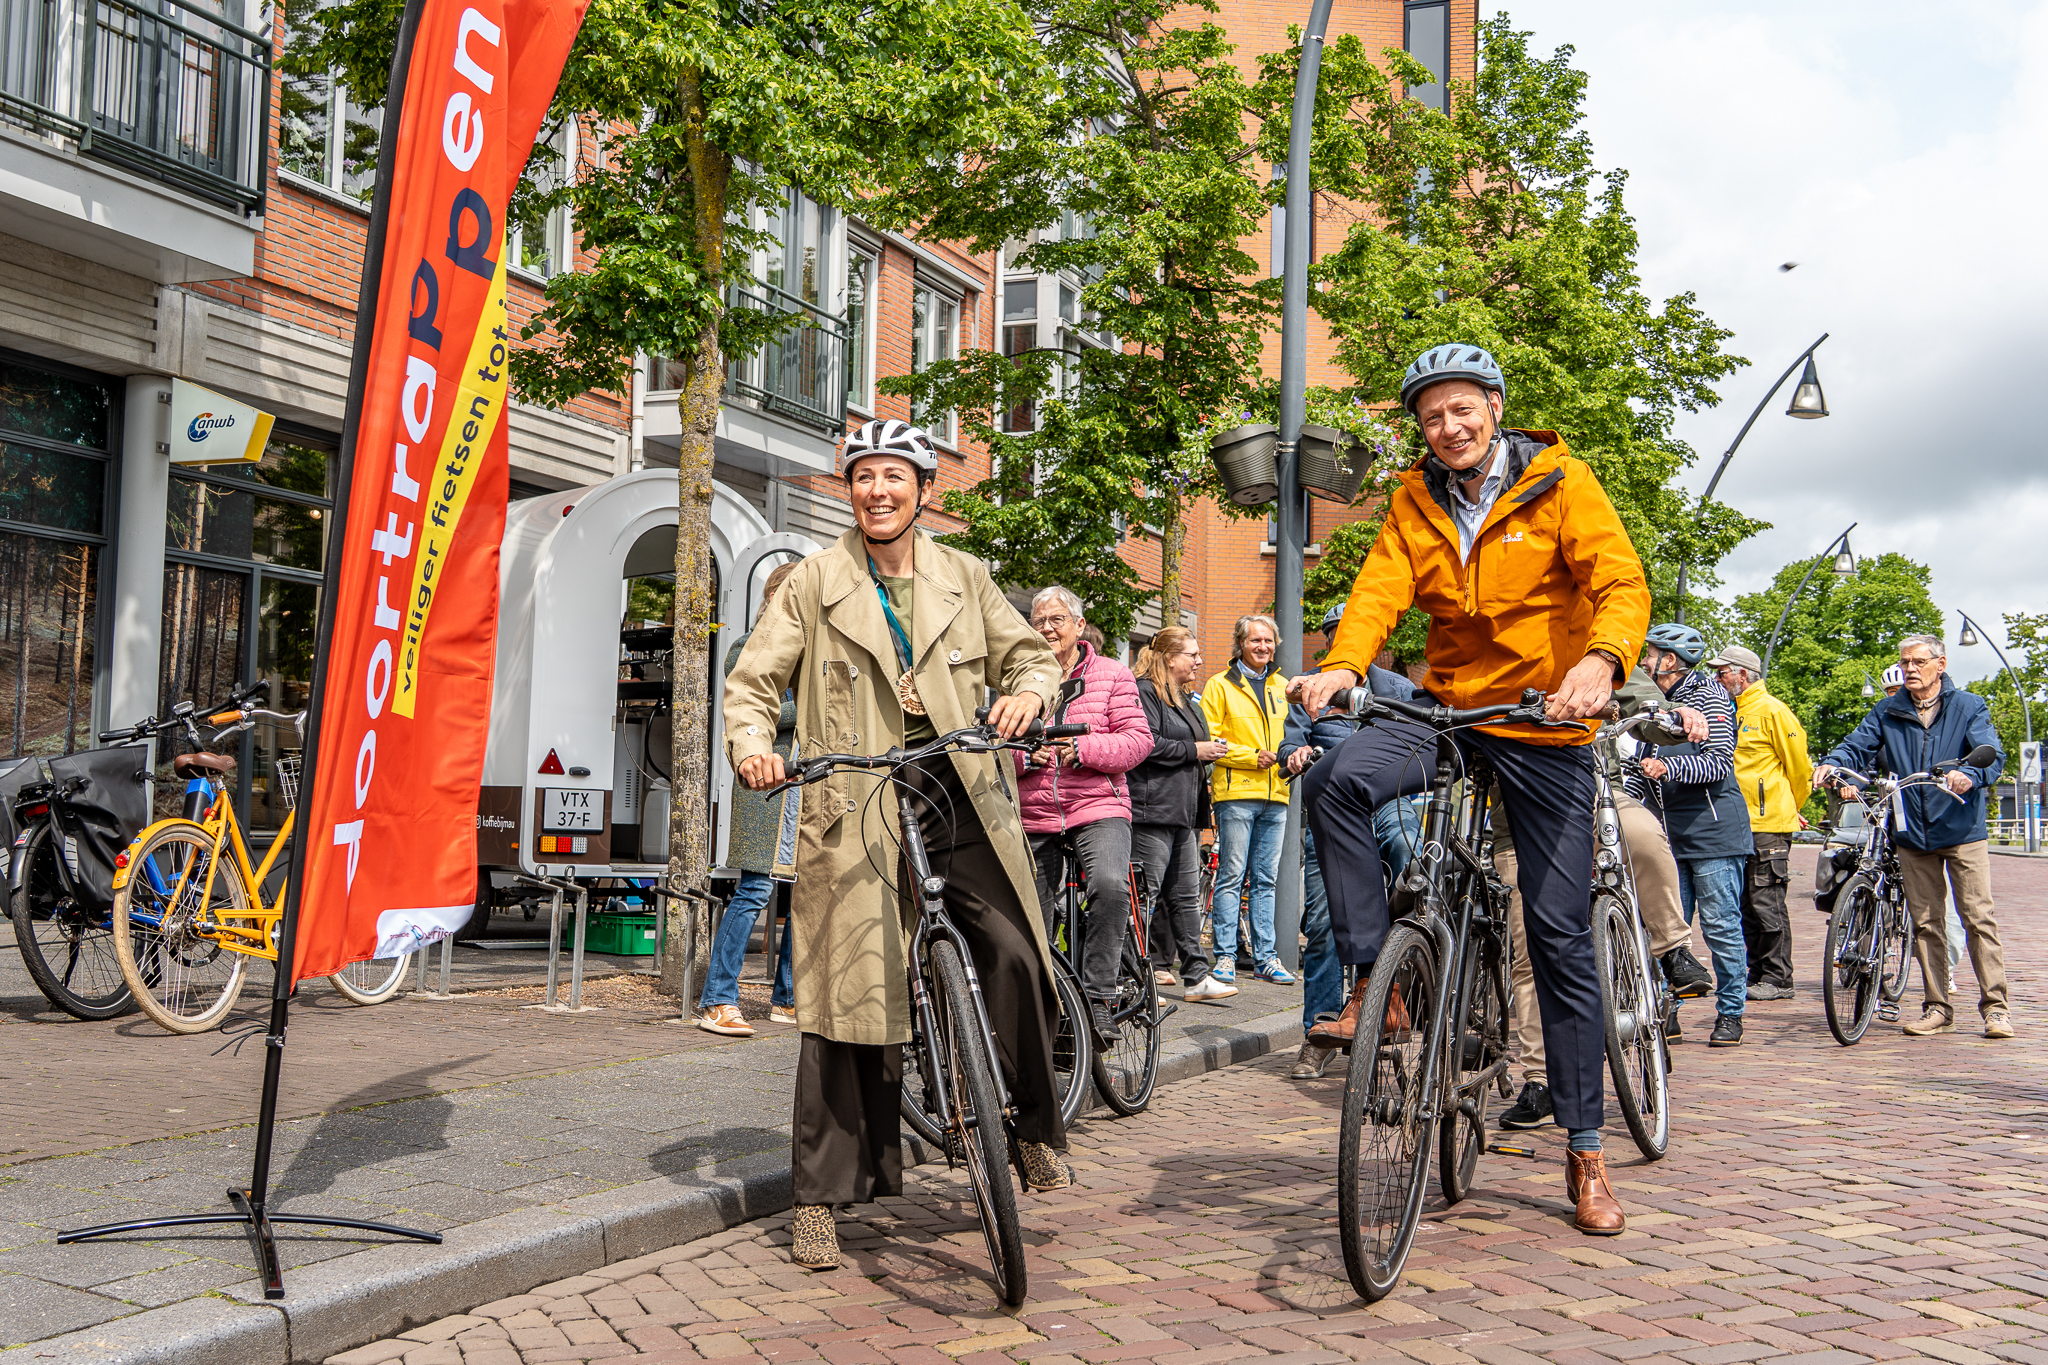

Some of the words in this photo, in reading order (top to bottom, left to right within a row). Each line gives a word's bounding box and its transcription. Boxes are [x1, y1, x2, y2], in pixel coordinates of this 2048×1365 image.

[197, 414, 235, 429] anwb
[403, 539, 438, 692] veiliger
[432, 396, 490, 527] fietsen
[477, 324, 507, 382] tot
[560, 791, 590, 808] VTX
[557, 811, 591, 827] 37-F
